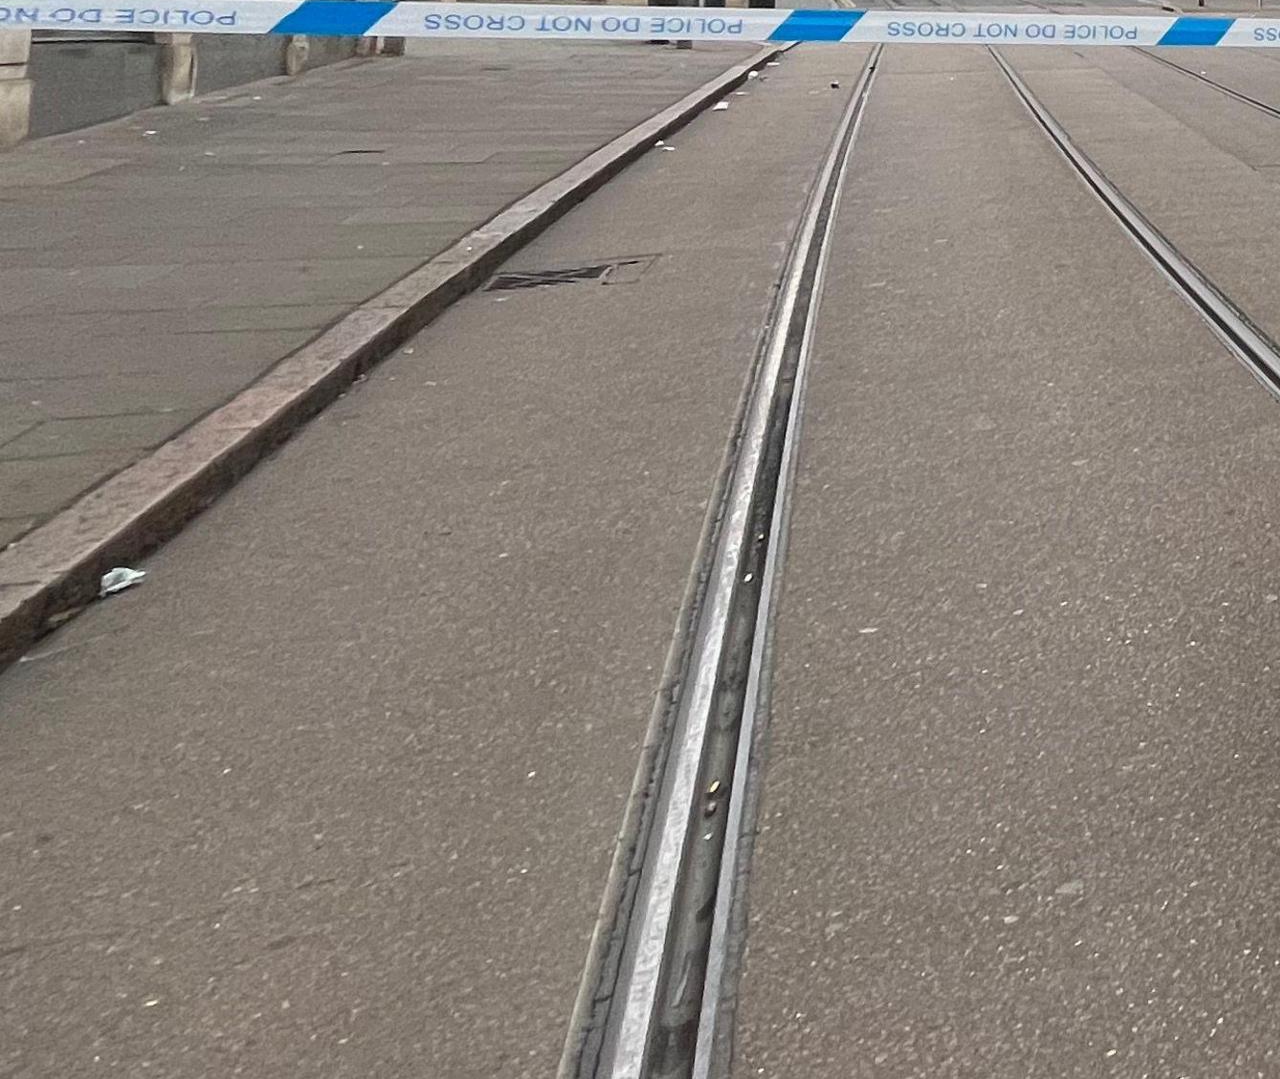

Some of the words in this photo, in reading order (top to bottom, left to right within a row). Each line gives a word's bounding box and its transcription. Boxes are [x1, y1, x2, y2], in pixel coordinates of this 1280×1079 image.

[48, 7, 103, 23] DO
[114, 8, 238, 26] POLICE
[424, 14, 525, 32] CROSS
[536, 15, 592, 33] NOT
[601, 17, 640, 33] DO
[650, 17, 744, 35] POLICE
[887, 21, 966, 37] CROSS
[974, 23, 1018, 38] NOT
[1025, 24, 1056, 39] DO
[1064, 24, 1138, 40] POLICE
